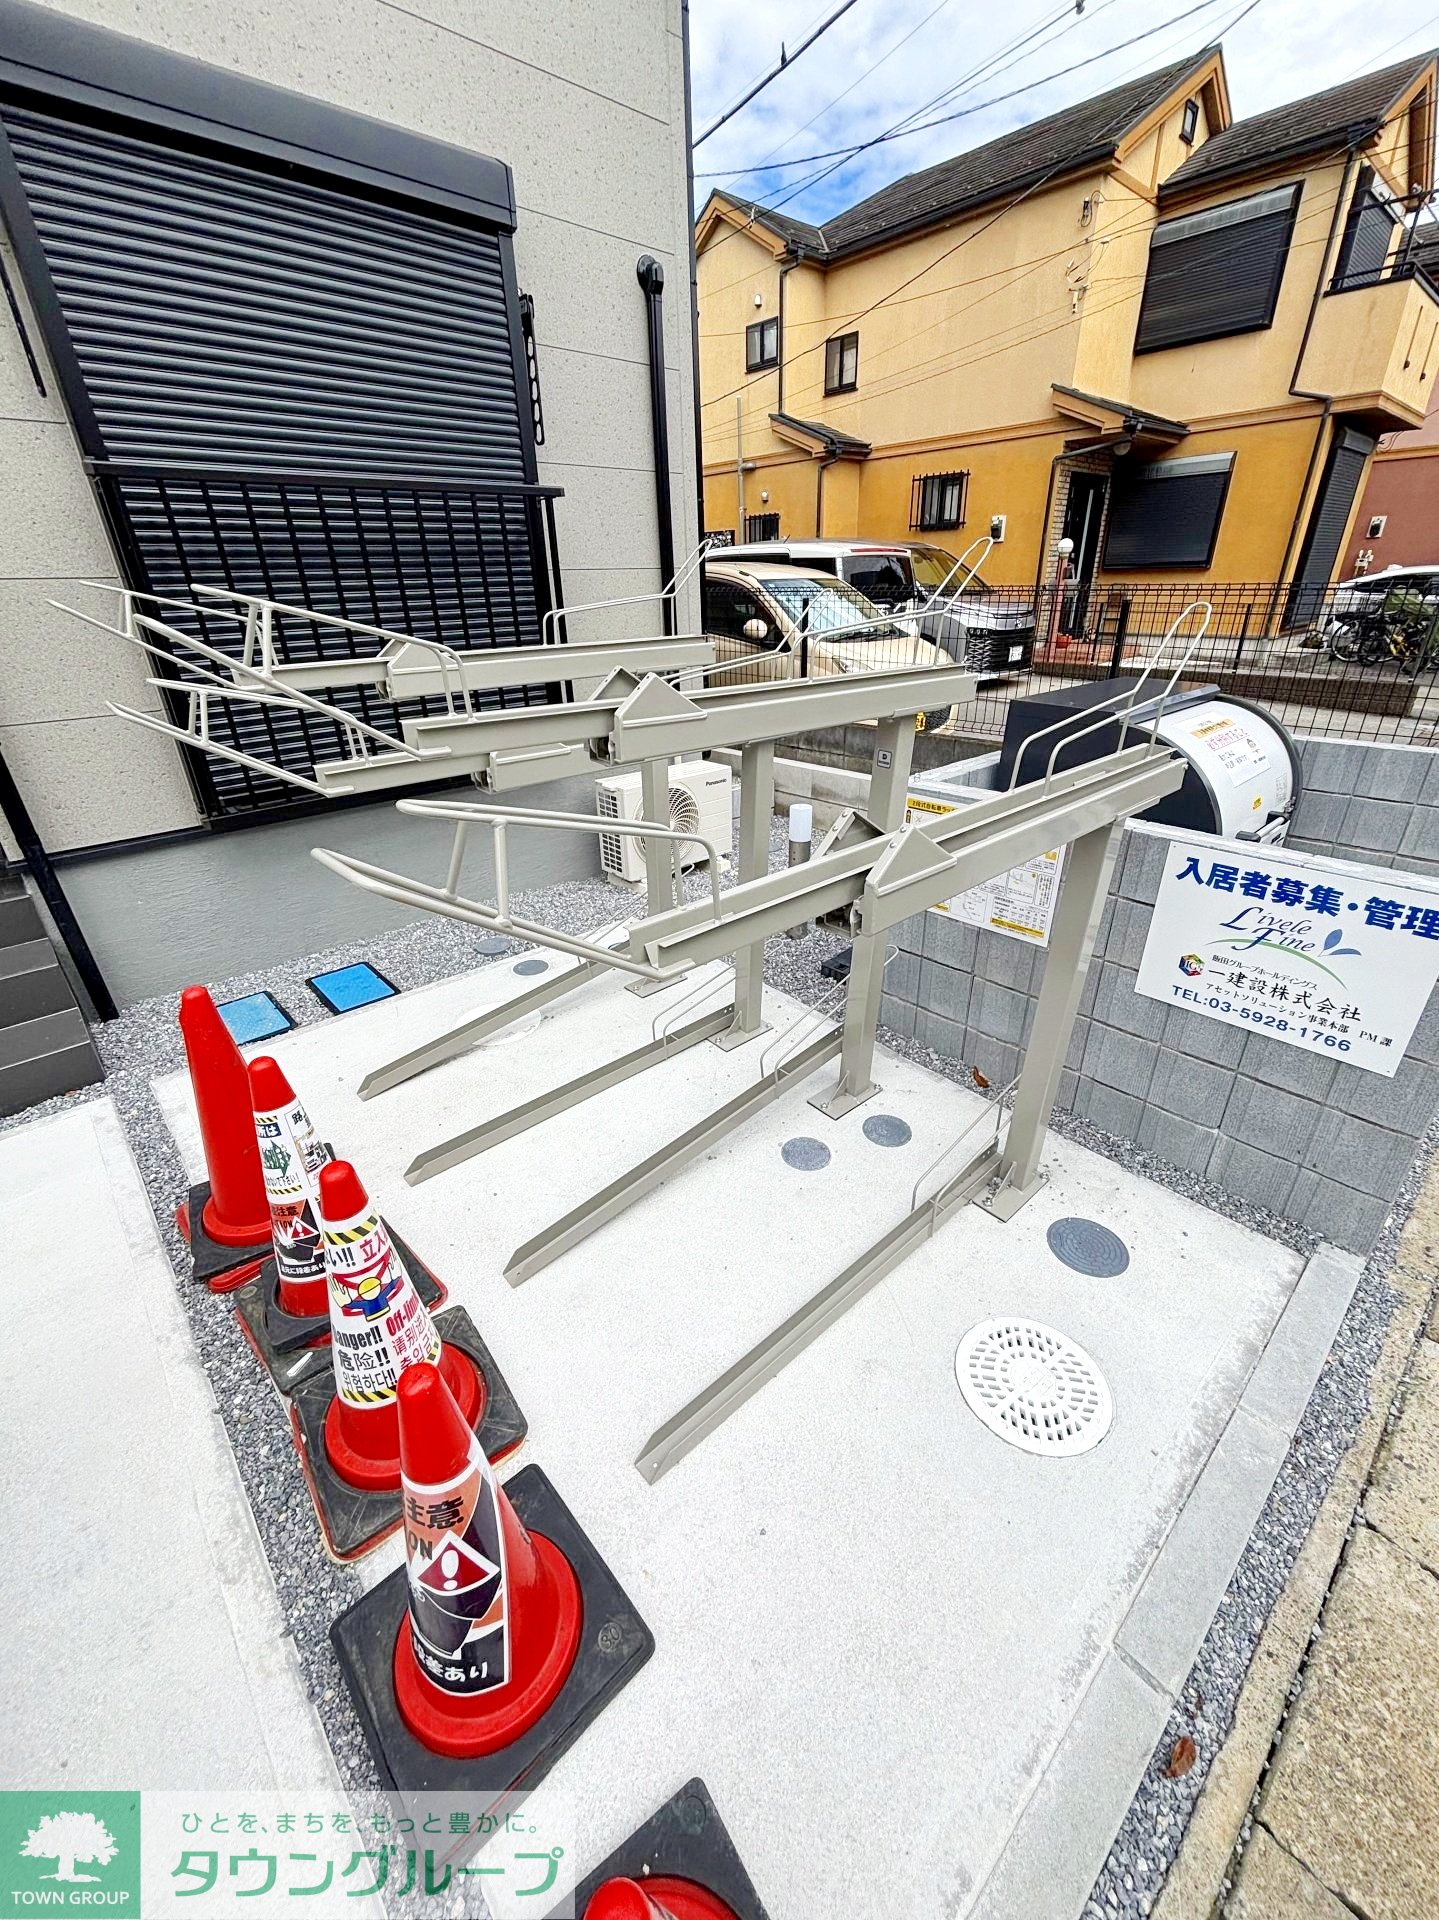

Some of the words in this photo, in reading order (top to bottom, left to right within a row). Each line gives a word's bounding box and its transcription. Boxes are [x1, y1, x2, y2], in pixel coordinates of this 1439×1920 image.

[705, 778, 728, 787] Panasonic
[1176, 856, 1439, 941] 入居者募集・管理
[1219, 906, 1313, 936] Livele
[1231, 926, 1316, 952] Fine
[1208, 969, 1362, 1023] 一建設株式会社
[1172, 984, 1352, 1052] TEL:03-5928-1766
